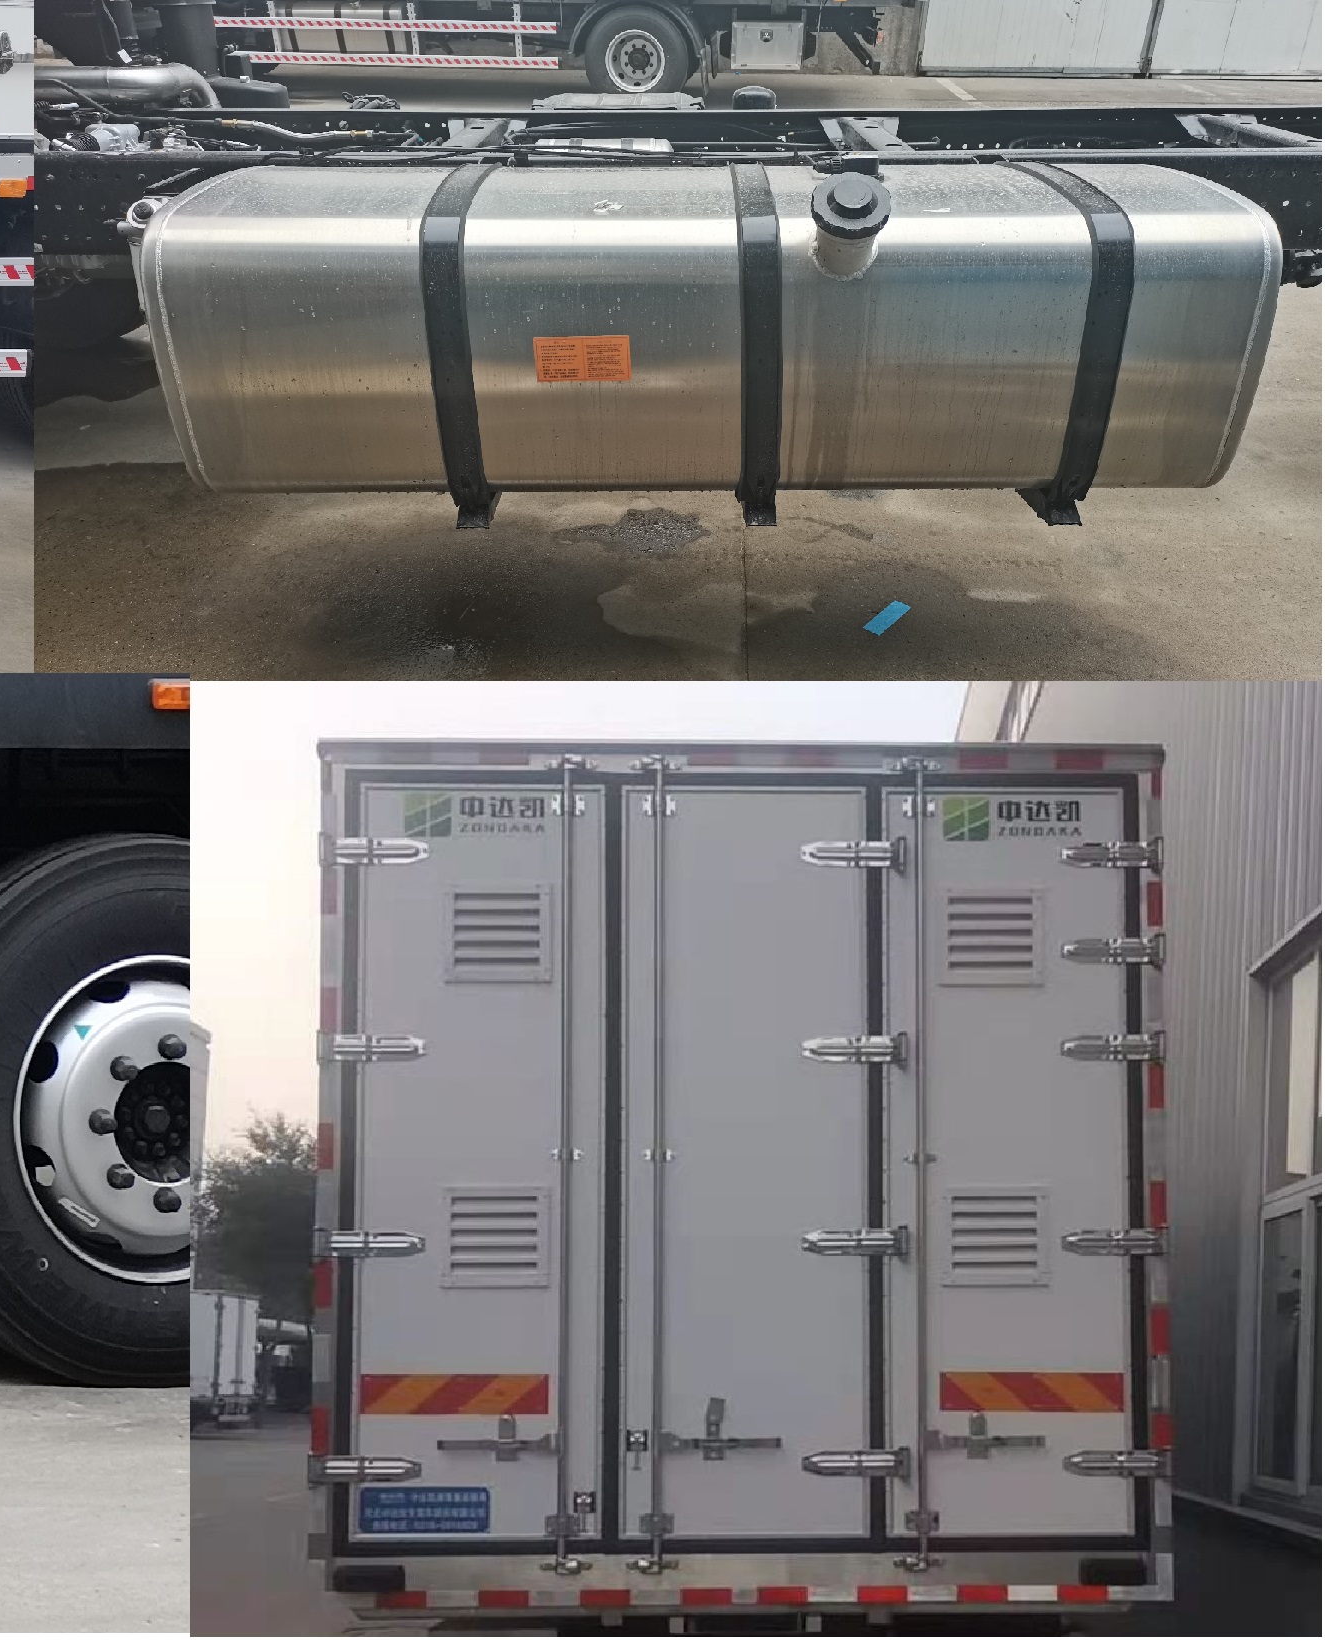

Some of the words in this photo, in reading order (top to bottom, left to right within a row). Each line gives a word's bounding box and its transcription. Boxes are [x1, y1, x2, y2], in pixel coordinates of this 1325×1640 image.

[460, 796, 546, 818] 中达凯
[997, 800, 1082, 822] 中达凯
